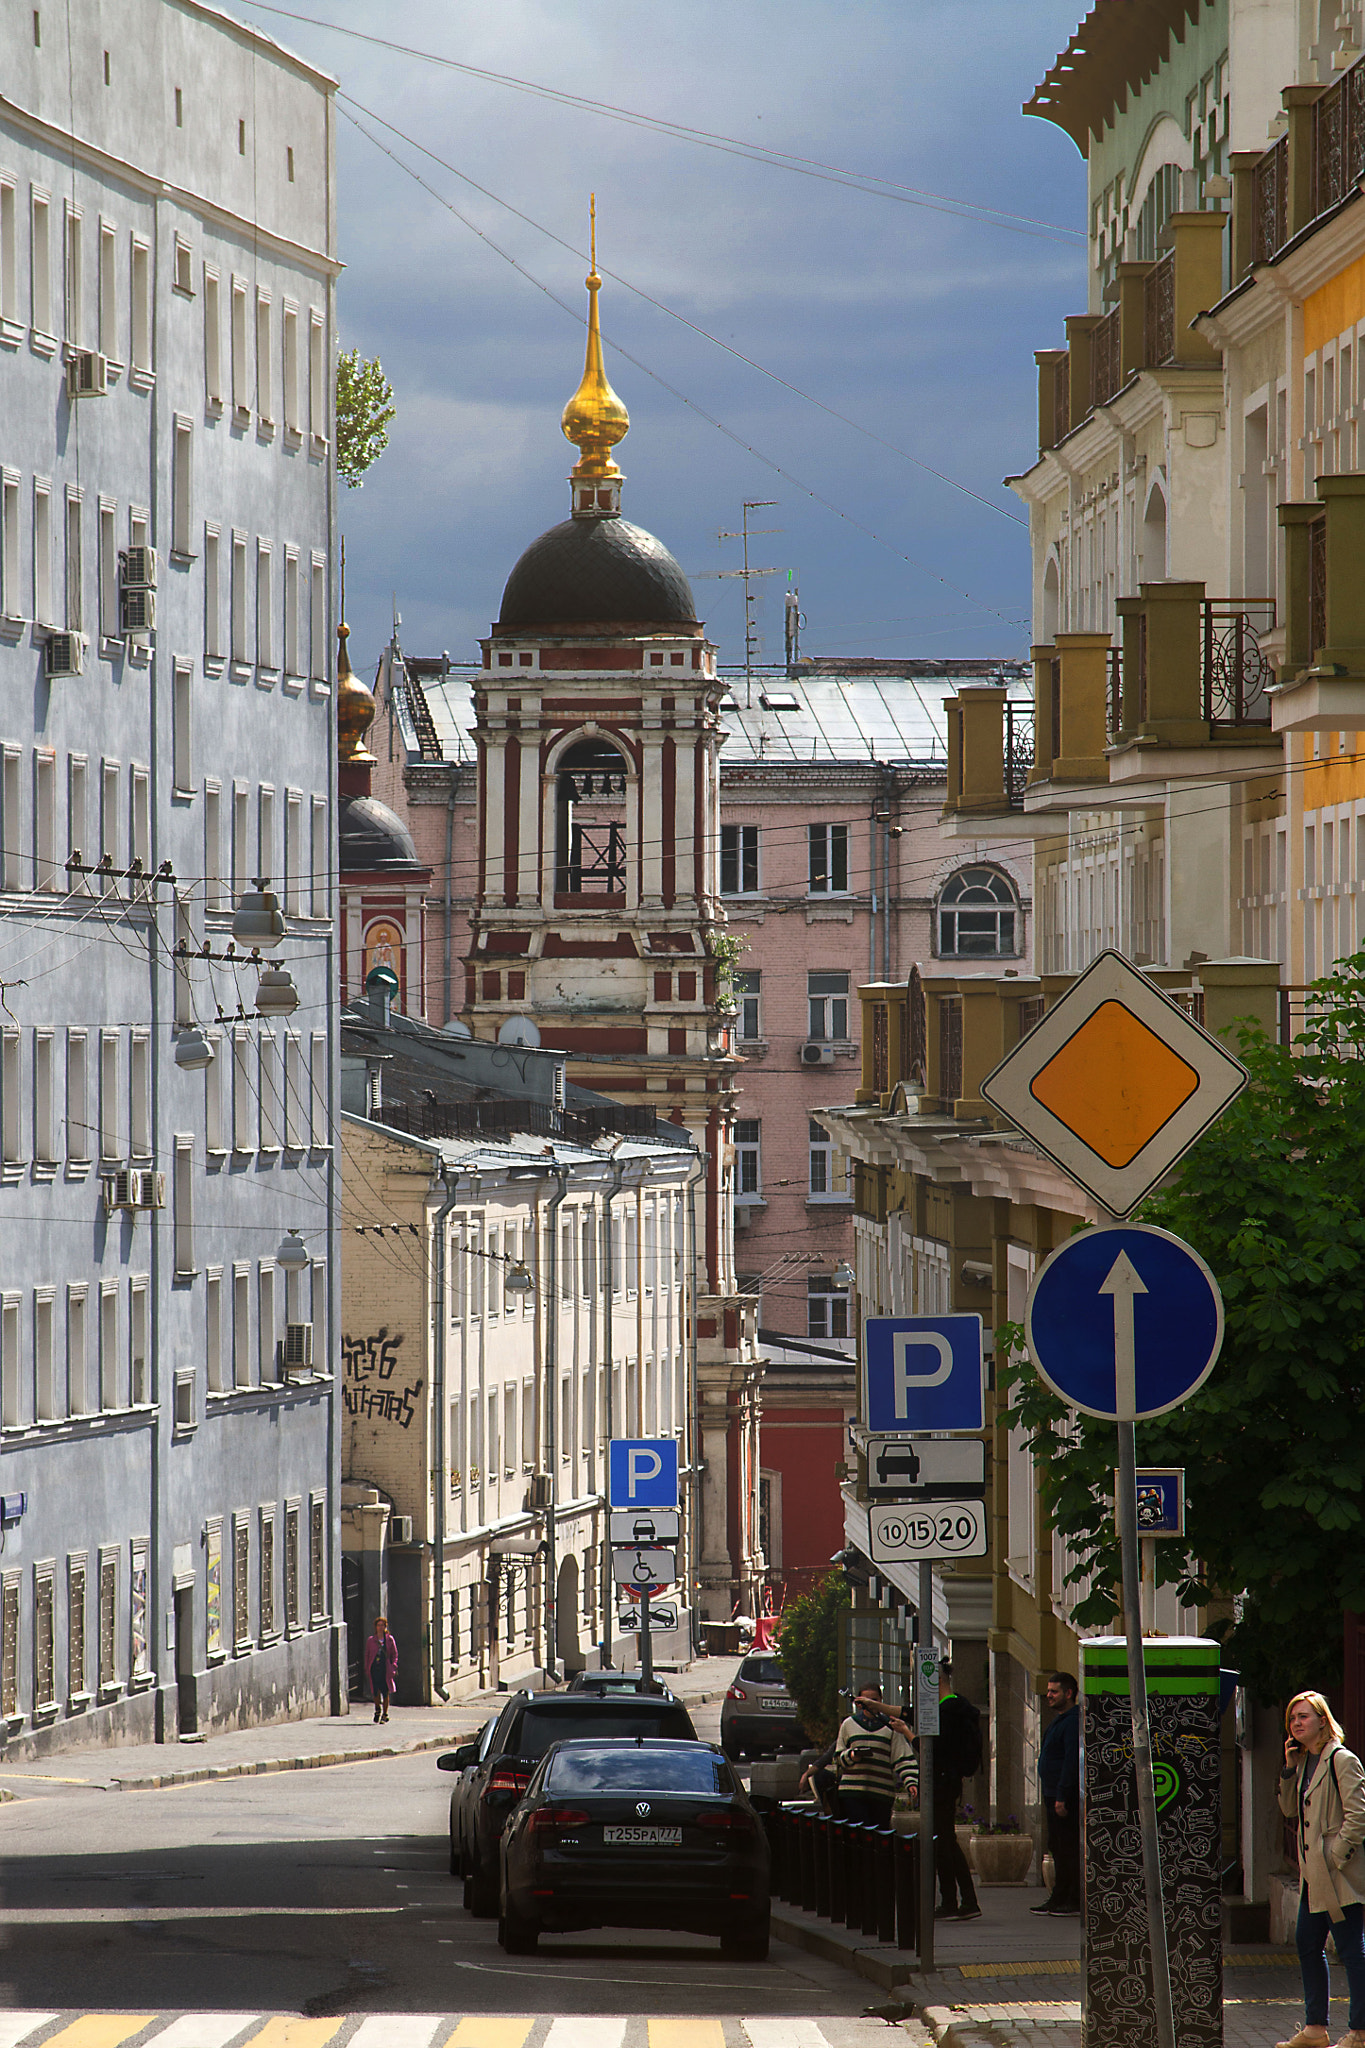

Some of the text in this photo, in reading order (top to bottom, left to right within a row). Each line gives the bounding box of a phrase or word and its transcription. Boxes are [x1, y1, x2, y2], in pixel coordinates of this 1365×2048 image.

[893, 1331, 953, 1419] P
[628, 1448, 662, 1498] P
[883, 1516, 971, 1541] 10 15 20
[920, 1653, 937, 1661] 1007
